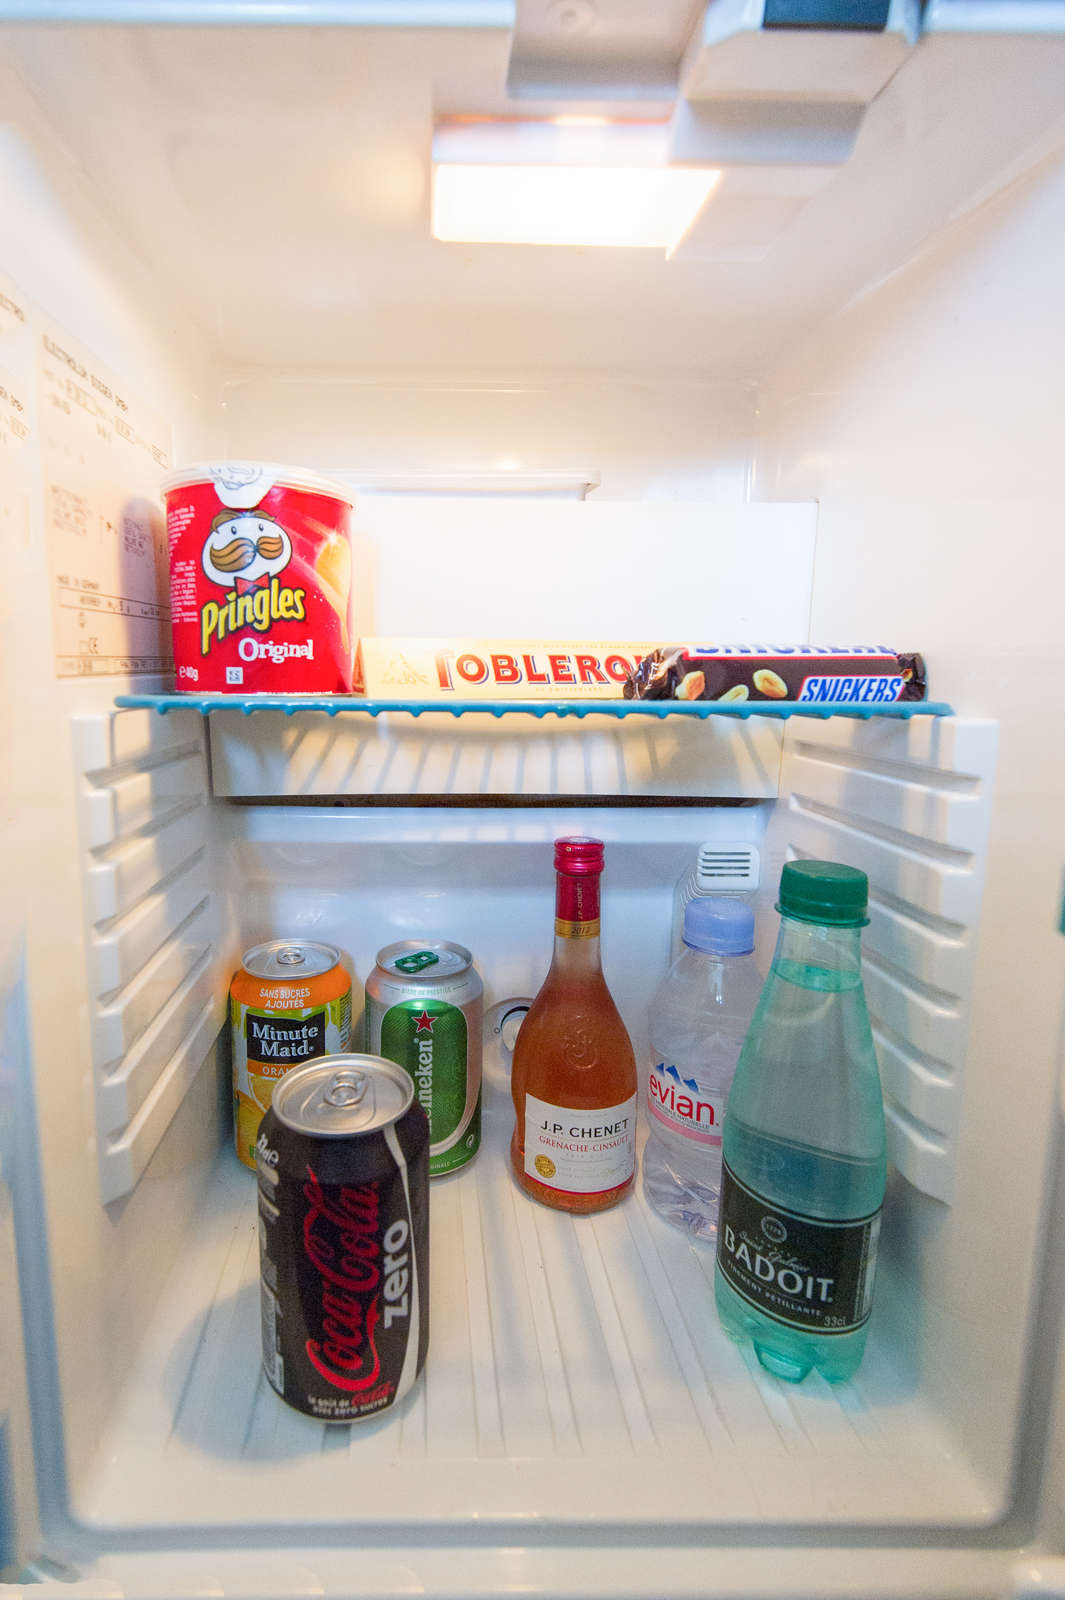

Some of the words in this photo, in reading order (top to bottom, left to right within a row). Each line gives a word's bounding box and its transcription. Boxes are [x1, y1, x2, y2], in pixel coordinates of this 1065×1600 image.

[200, 576, 307, 658] Pringles
[238, 637, 315, 664] Original
[434, 650, 645, 691] TOBLERO
[801, 677, 904, 702] SNICKERS
[258, 987, 279, 999] SANS
[279, 987, 312, 1000] SUCRES
[252, 1021, 319, 1041] Minute
[260, 1039, 311, 1058] Maid
[261, 1065, 290, 1077] ORA
[414, 1037, 433, 1134] ineken
[540, 1120, 564, 1136] J.P.
[568, 1117, 630, 1139] CHENET
[382, 1218, 409, 1330] zero
